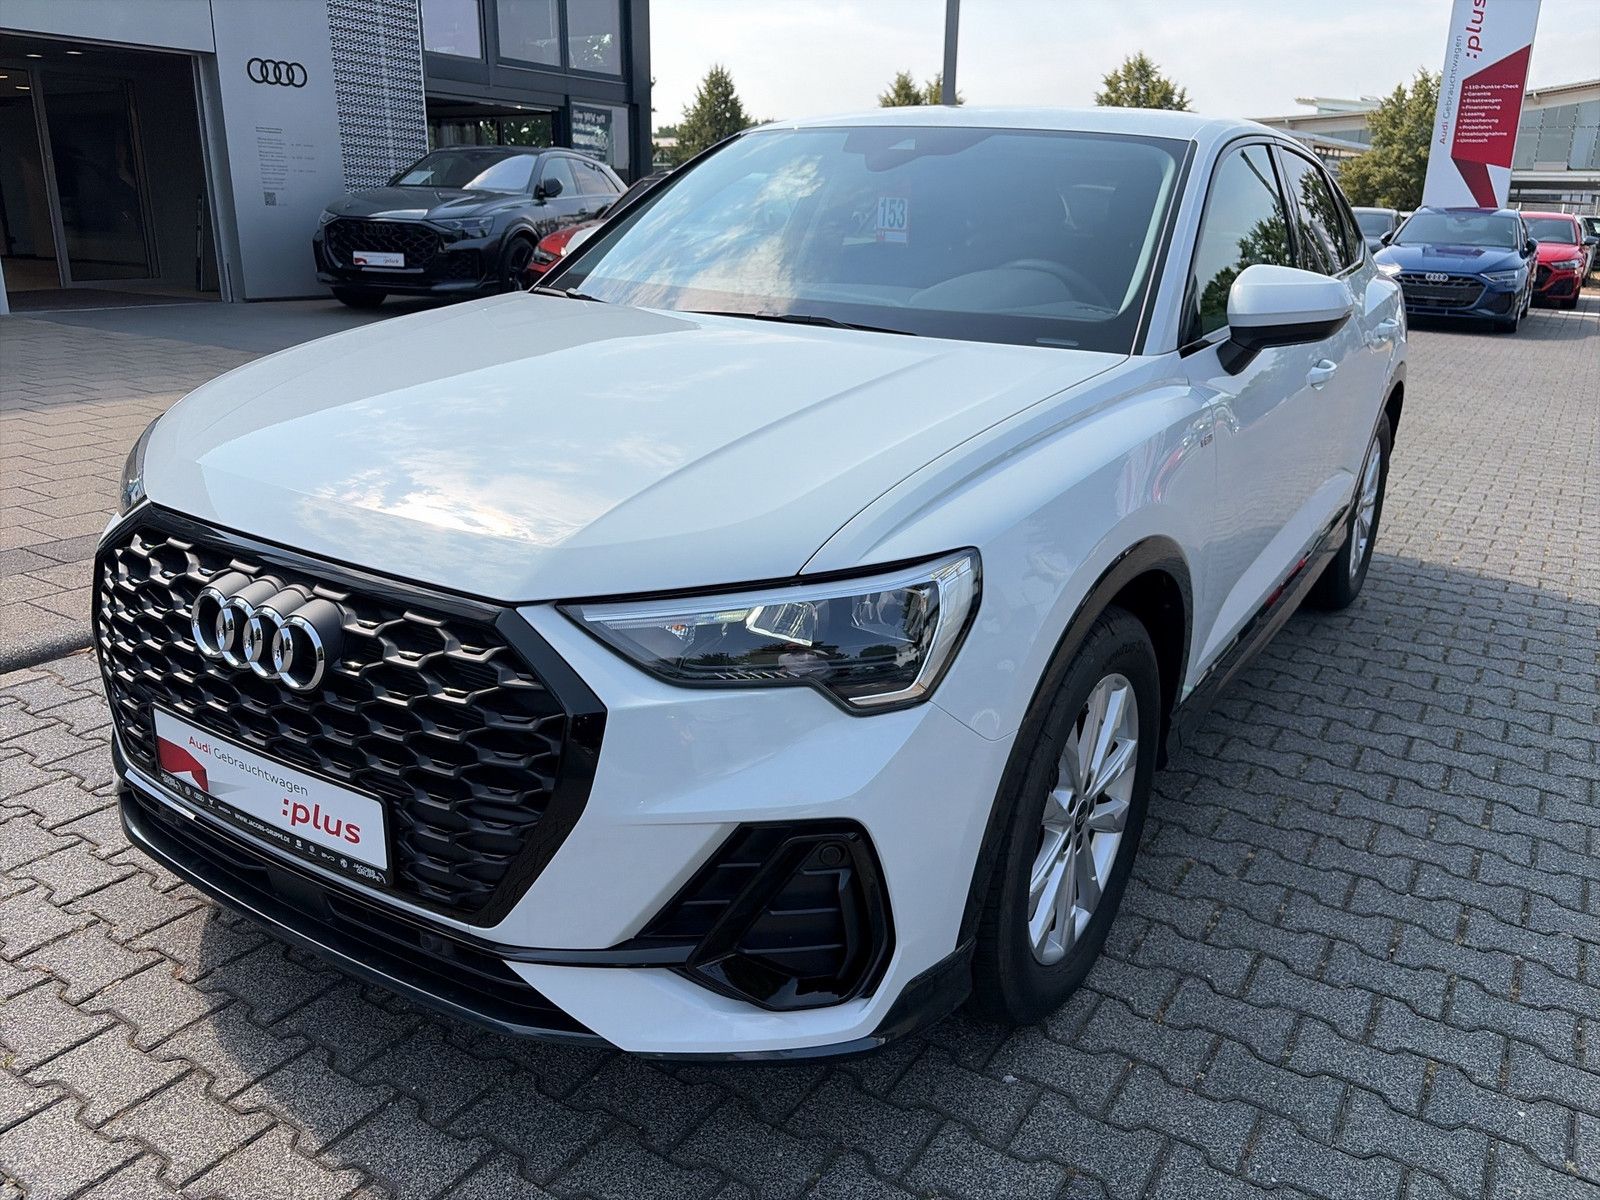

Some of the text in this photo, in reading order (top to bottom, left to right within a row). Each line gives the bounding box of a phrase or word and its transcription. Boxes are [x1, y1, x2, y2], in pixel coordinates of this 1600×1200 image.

[1440, 35, 1462, 145] Audi Gebrauchtwagen
[880, 198, 906, 228] 153
[188, 735, 212, 755] Audi
[213, 746, 309, 797] Gebrauchtwagen
[282, 797, 362, 845] :plus
